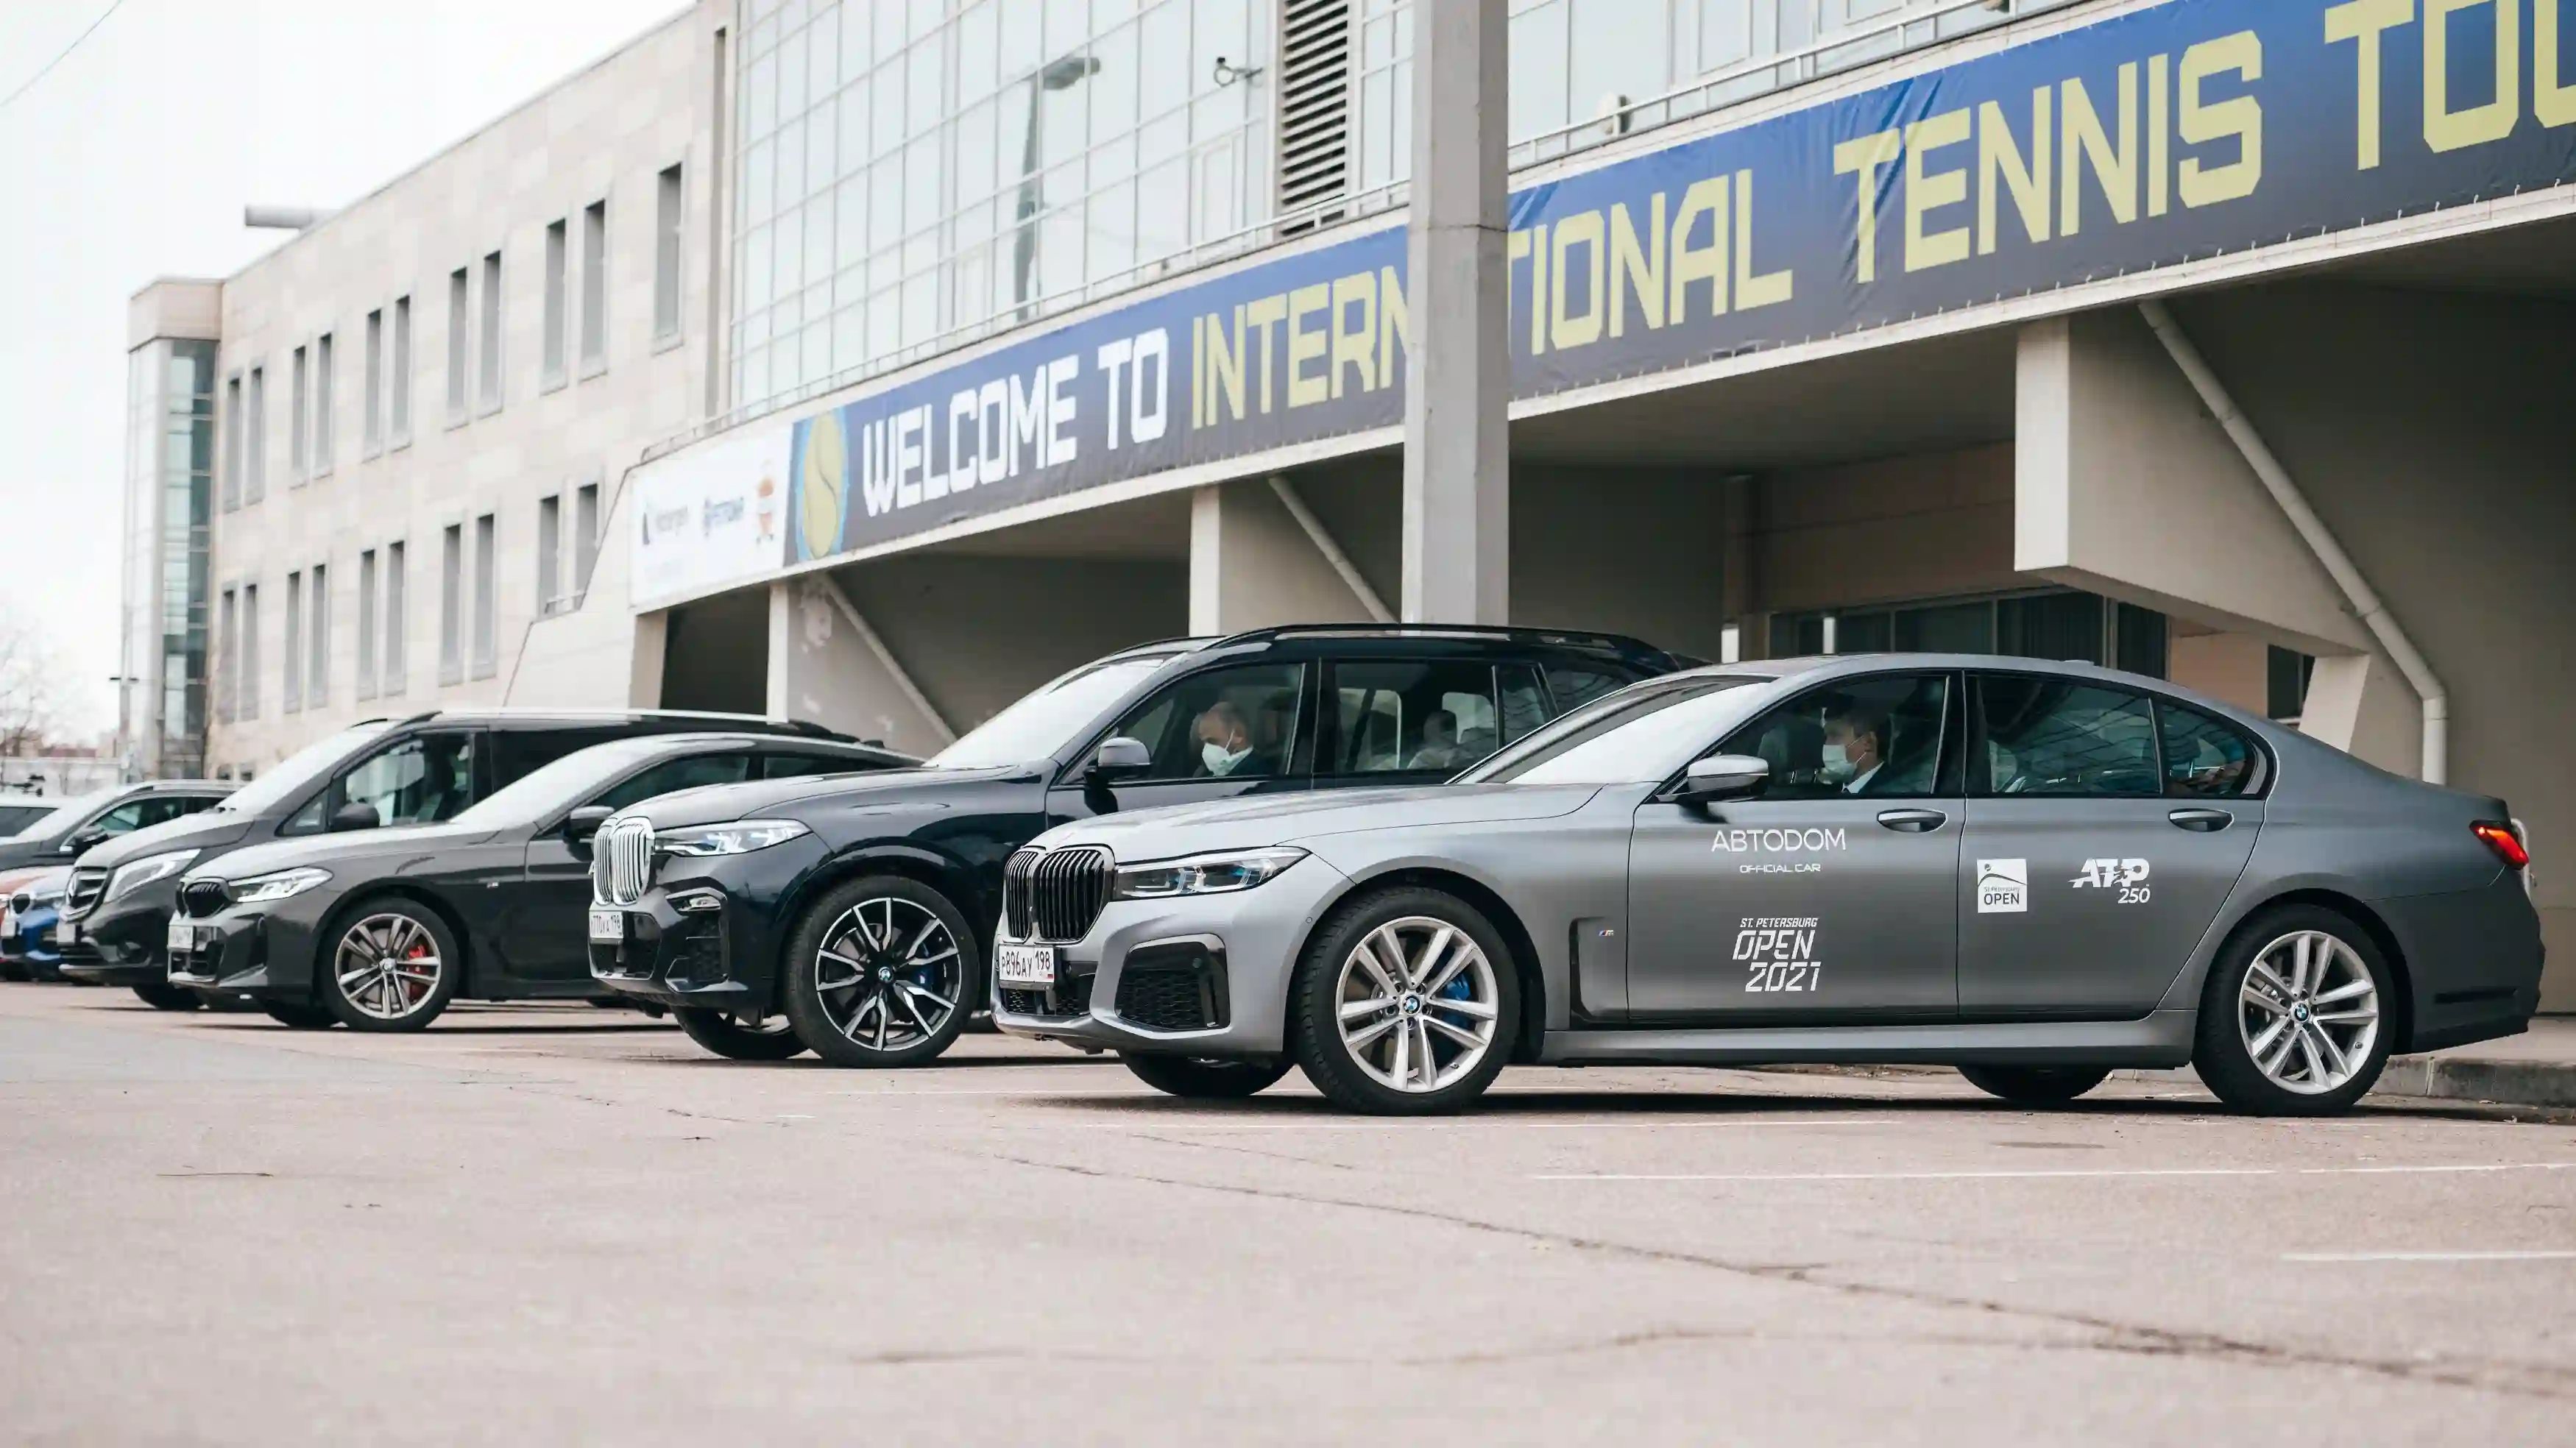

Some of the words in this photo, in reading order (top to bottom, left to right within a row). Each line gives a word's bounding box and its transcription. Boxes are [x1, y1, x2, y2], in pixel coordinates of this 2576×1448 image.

[863, 354, 1079, 517] WELCOME
[1097, 327, 1169, 451] TO
[1833, 29, 2262, 285] TENNIS
[1711, 828, 1847, 852] ABTODOM
[1739, 865, 1793, 874] OFFICIAL
[1794, 863, 1821, 873] CAR
[2068, 858, 2150, 887] ATP
[1984, 892, 2020, 905] OPEN
[2117, 887, 2151, 904] 250
[1740, 918, 1754, 928] ST.
[1755, 918, 1819, 928] PETERSBURG
[1732, 929, 1816, 960] OPEN
[1035, 951, 1050, 970] 198
[1745, 962, 1822, 992] 2021
